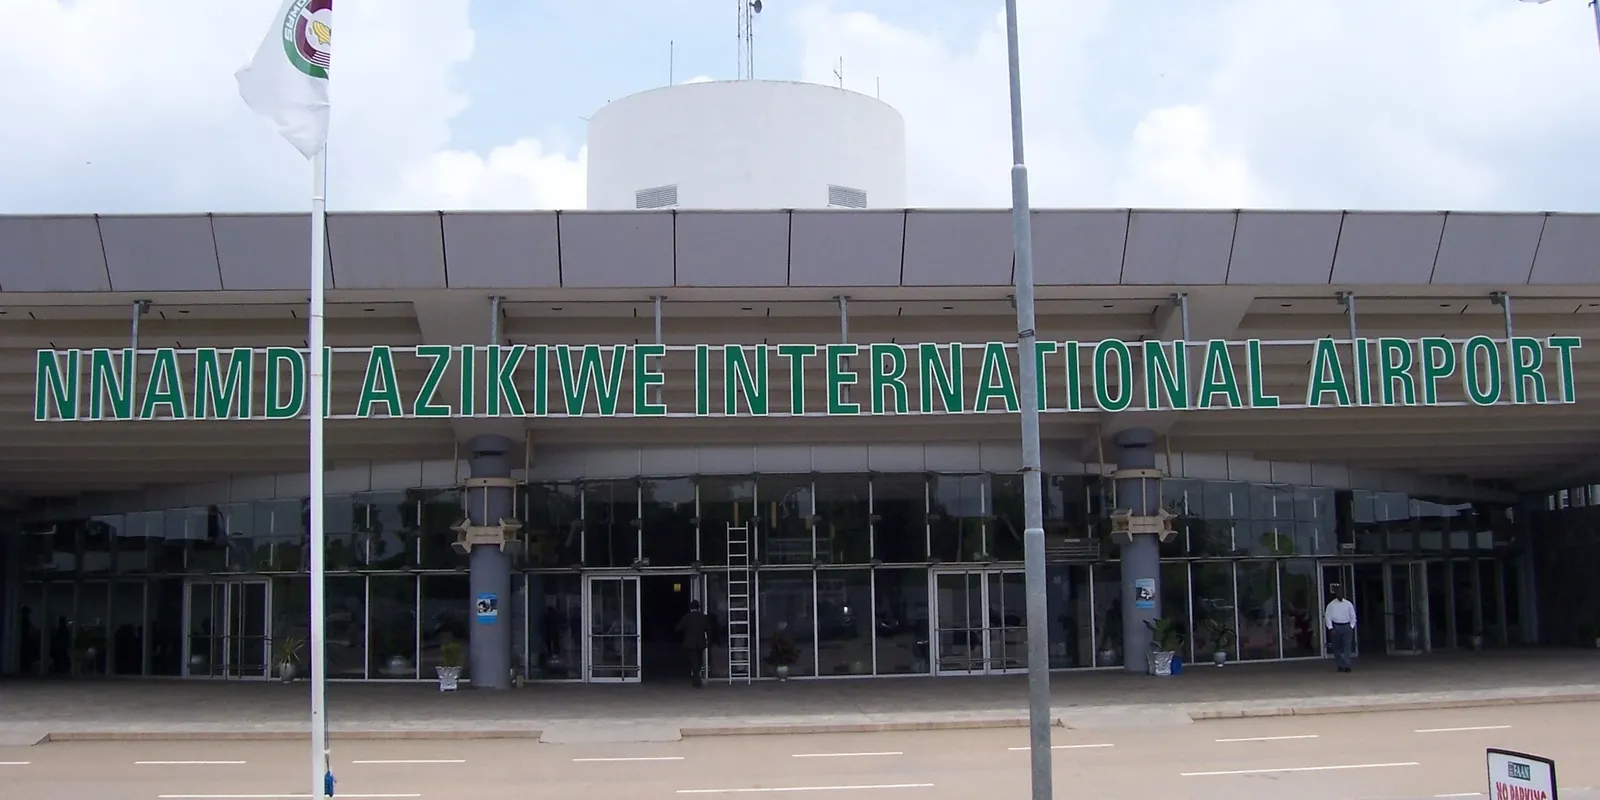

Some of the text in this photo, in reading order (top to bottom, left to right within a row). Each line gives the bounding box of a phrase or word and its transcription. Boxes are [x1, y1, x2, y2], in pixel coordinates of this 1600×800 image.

[35, 335, 1582, 421] NNAMDI AZIKIWE INTERNATIONAL AIRPORT
[1496, 781, 1508, 800] NO
